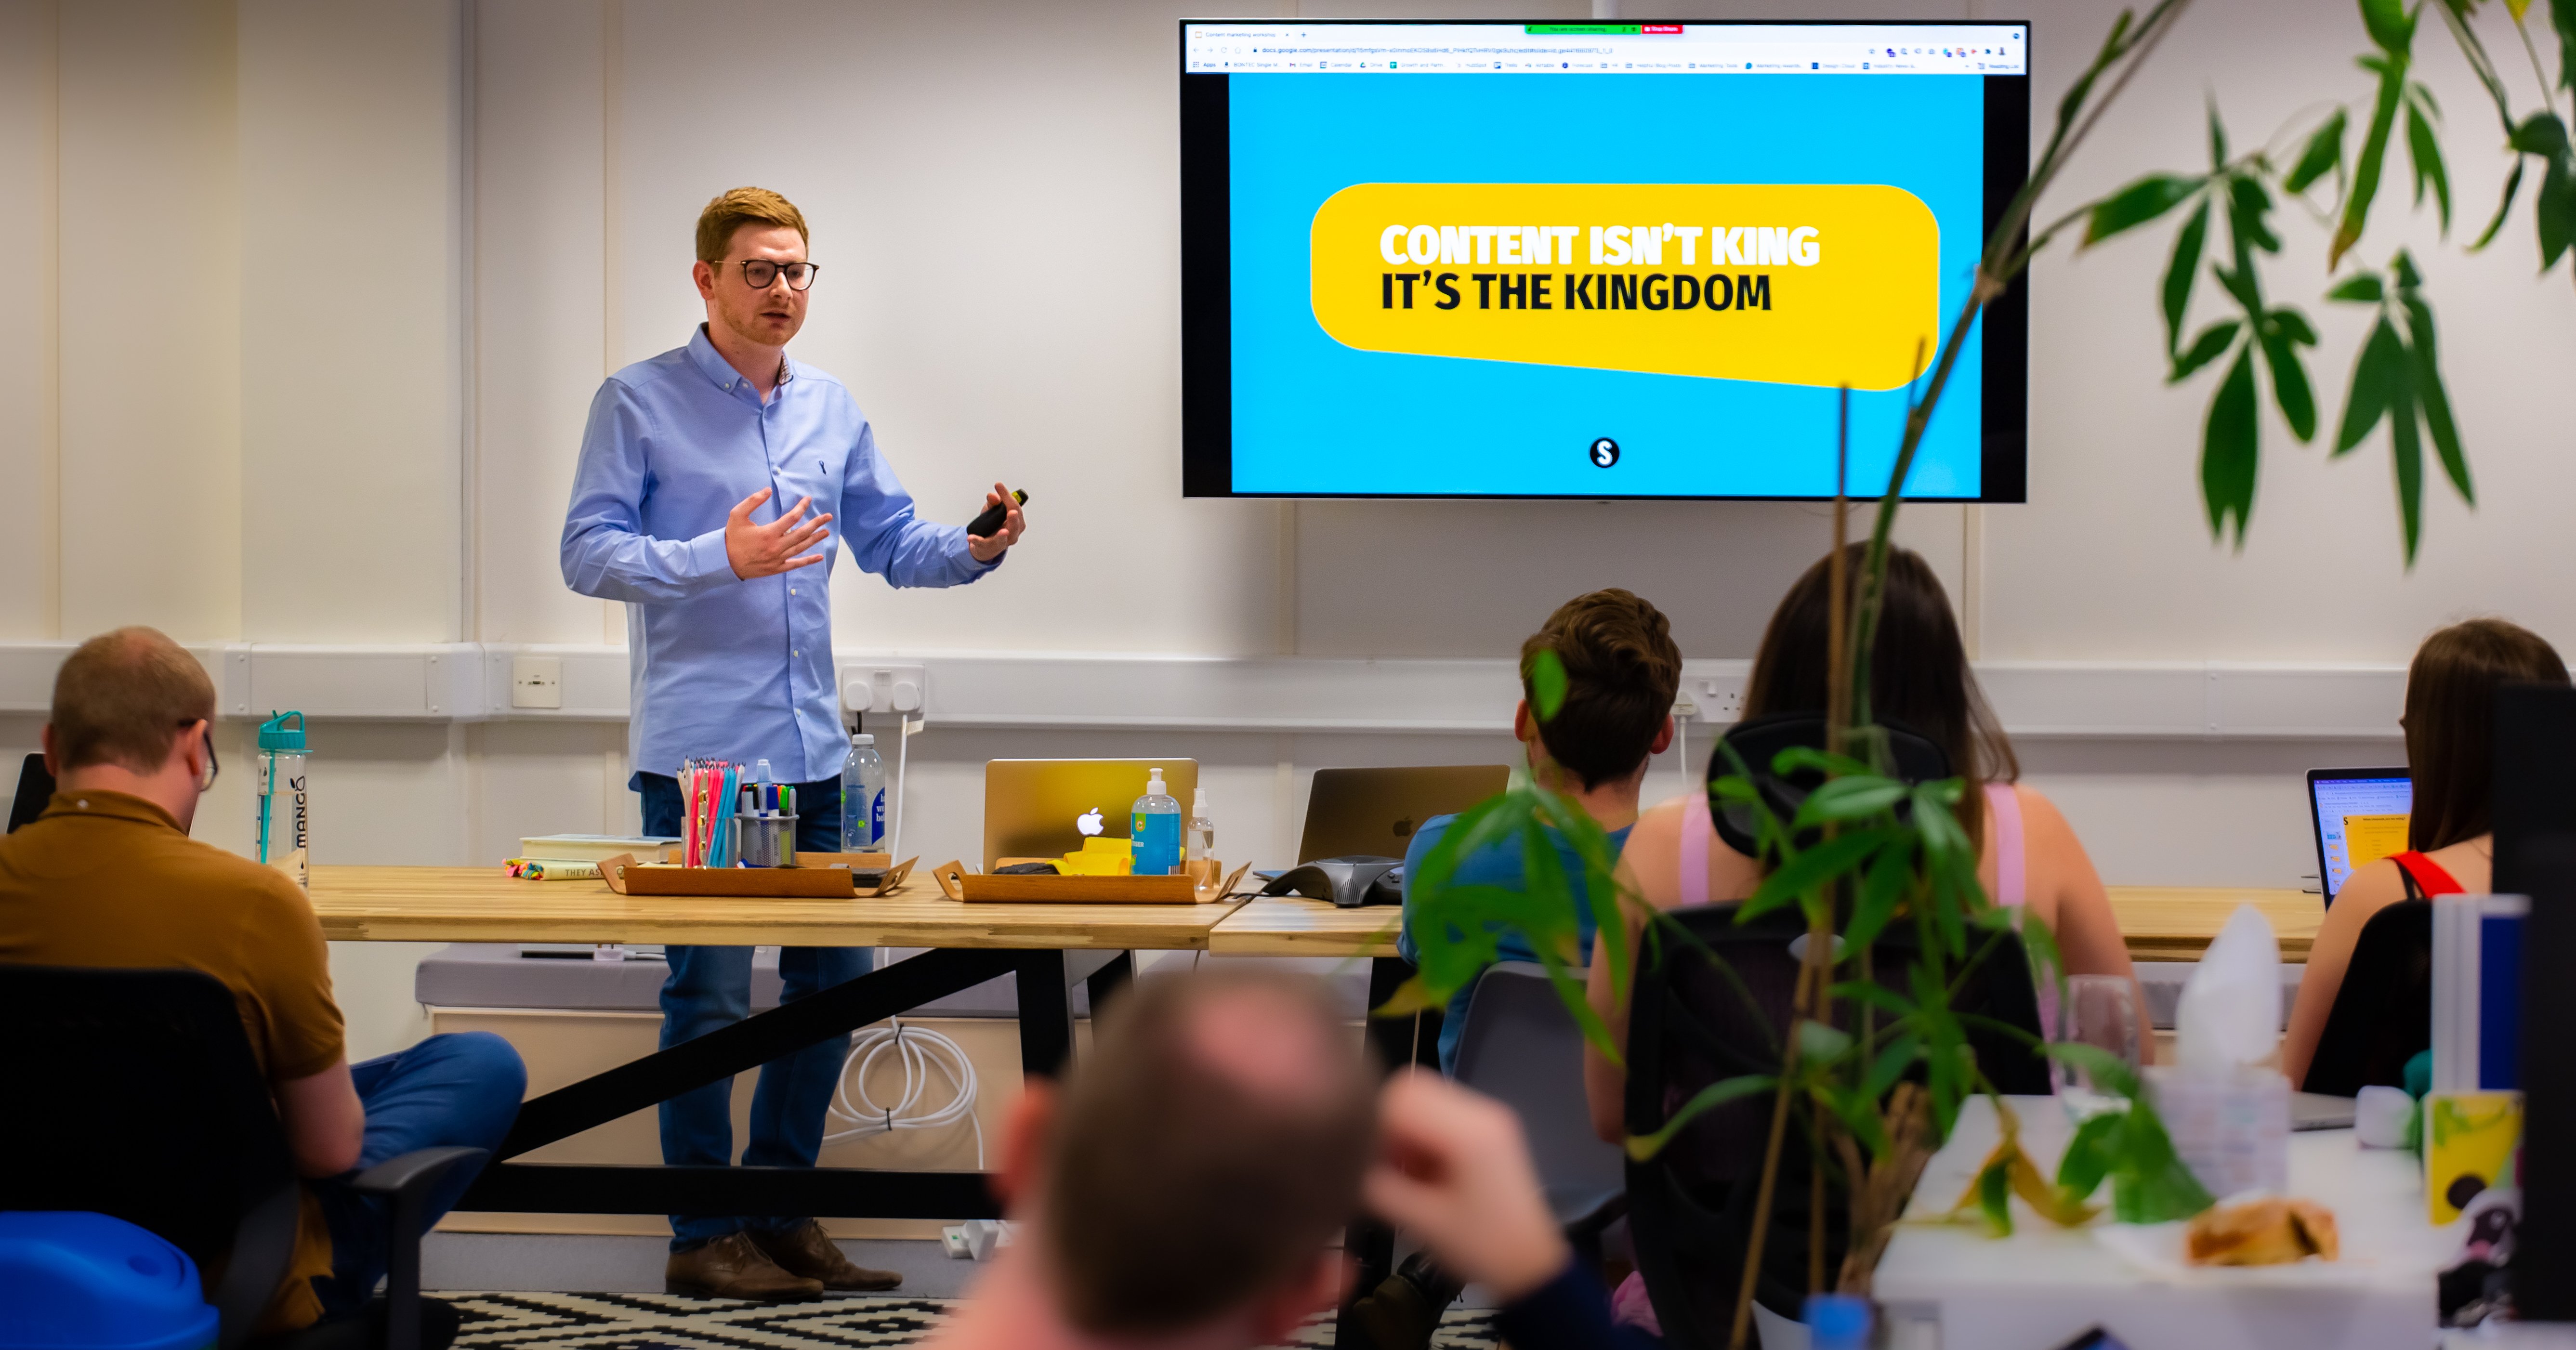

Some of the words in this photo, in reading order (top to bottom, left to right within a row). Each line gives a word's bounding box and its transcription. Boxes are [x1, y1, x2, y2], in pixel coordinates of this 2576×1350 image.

[1380, 224, 1580, 265] CONTENT
[1590, 223, 1703, 266] ISN’T
[1712, 225, 1820, 266] KING
[1382, 269, 1461, 310] IT’S
[1472, 273, 1552, 310] THE
[1564, 273, 1772, 311] KINGDOM
[1597, 440, 1613, 466] S
[296, 775, 306, 848] MANGO
